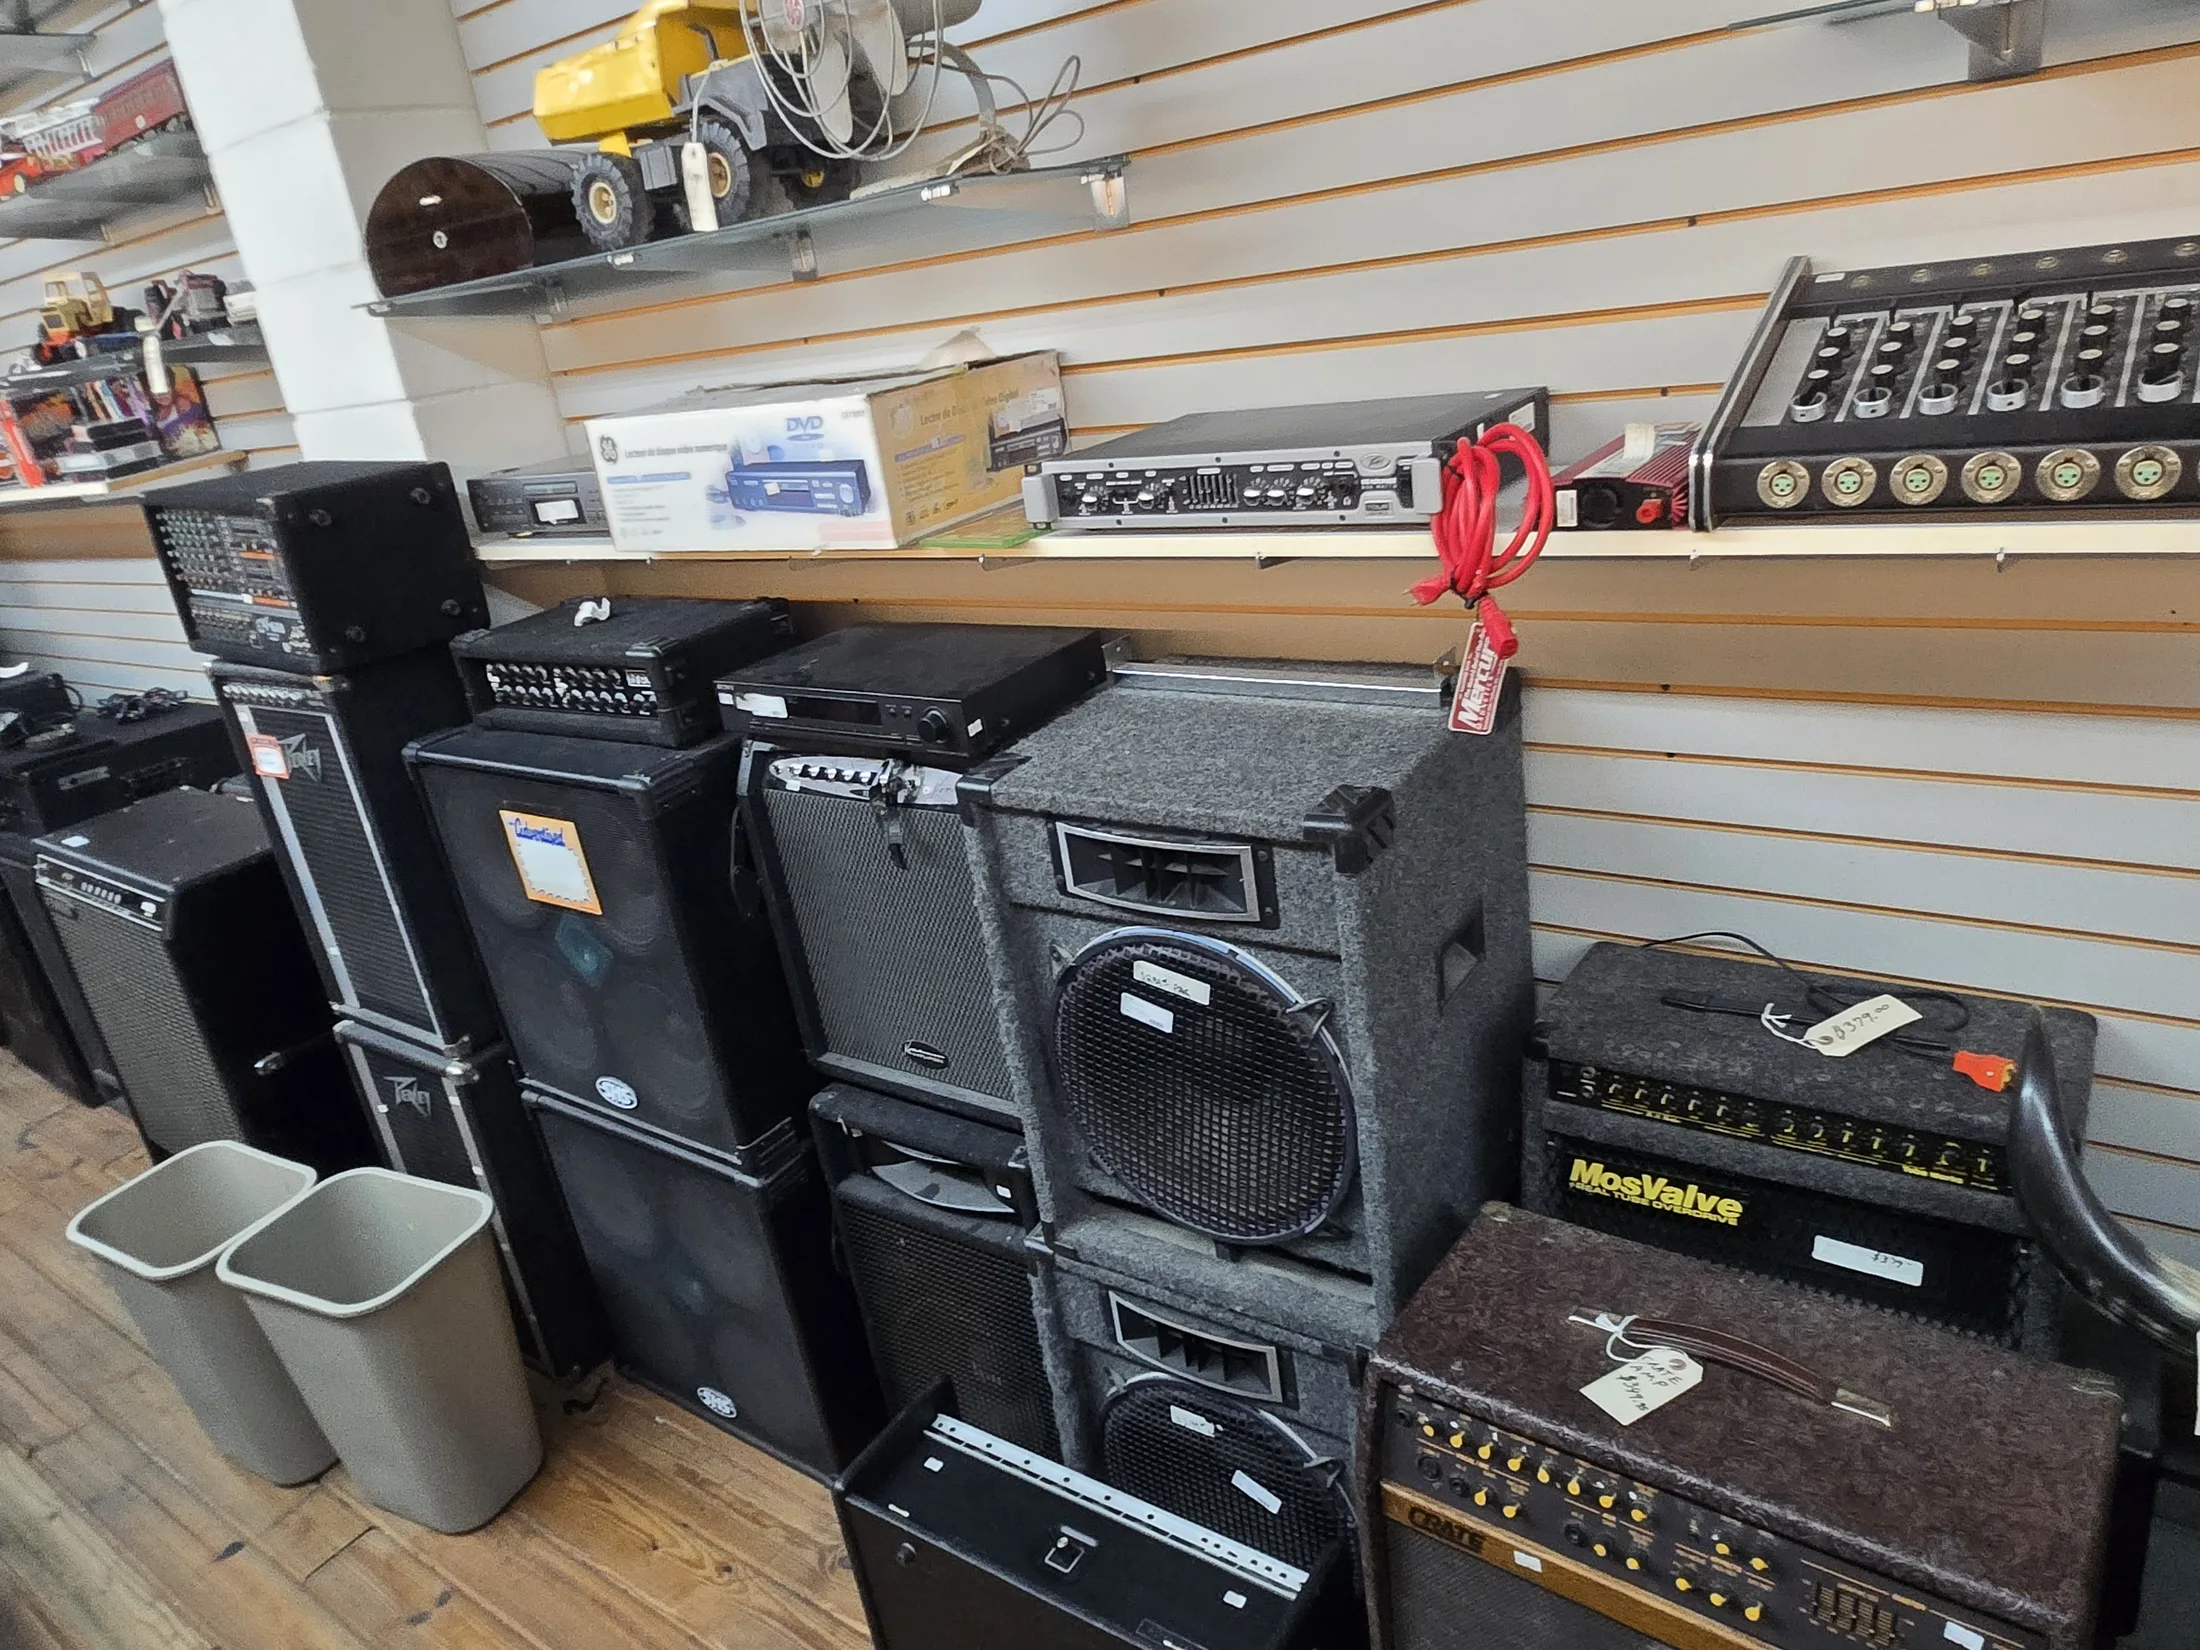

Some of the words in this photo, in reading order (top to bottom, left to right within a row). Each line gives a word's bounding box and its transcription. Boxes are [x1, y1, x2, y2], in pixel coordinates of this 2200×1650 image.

[786, 416, 824, 432] DVD
[1457, 648, 1500, 730] Mercur
[1569, 1159, 1743, 1218] MosValve
[1652, 1201, 1738, 1226] OVERDRIVE
